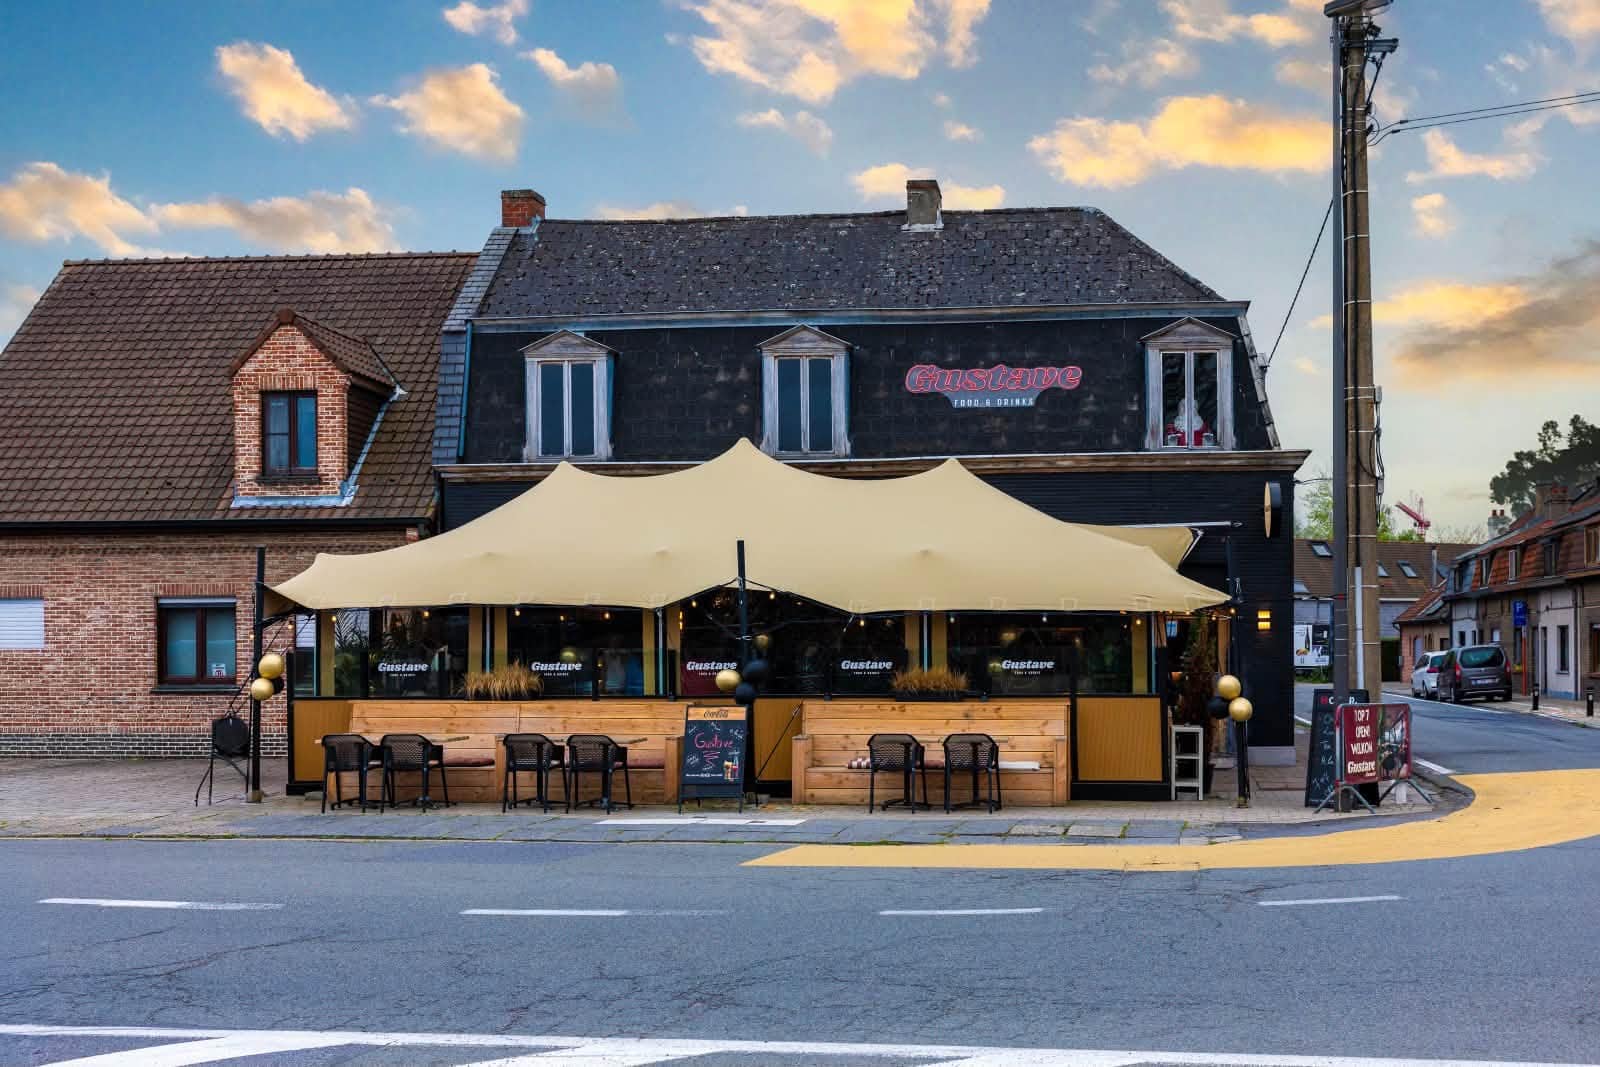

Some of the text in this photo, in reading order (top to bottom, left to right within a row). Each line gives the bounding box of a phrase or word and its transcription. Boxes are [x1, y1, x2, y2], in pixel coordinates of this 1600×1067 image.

[905, 364, 1083, 393] Gustave
[954, 399, 979, 408] FOOD
[997, 398, 1034, 407] DRINKS
[378, 662, 428, 672] Gustave
[531, 662, 582, 671] Gustave
[687, 661, 737, 671] Gustave
[841, 660, 893, 670] Gustave
[1001, 660, 1054, 670] Gustave
[1347, 760, 1376, 774] Gustave
